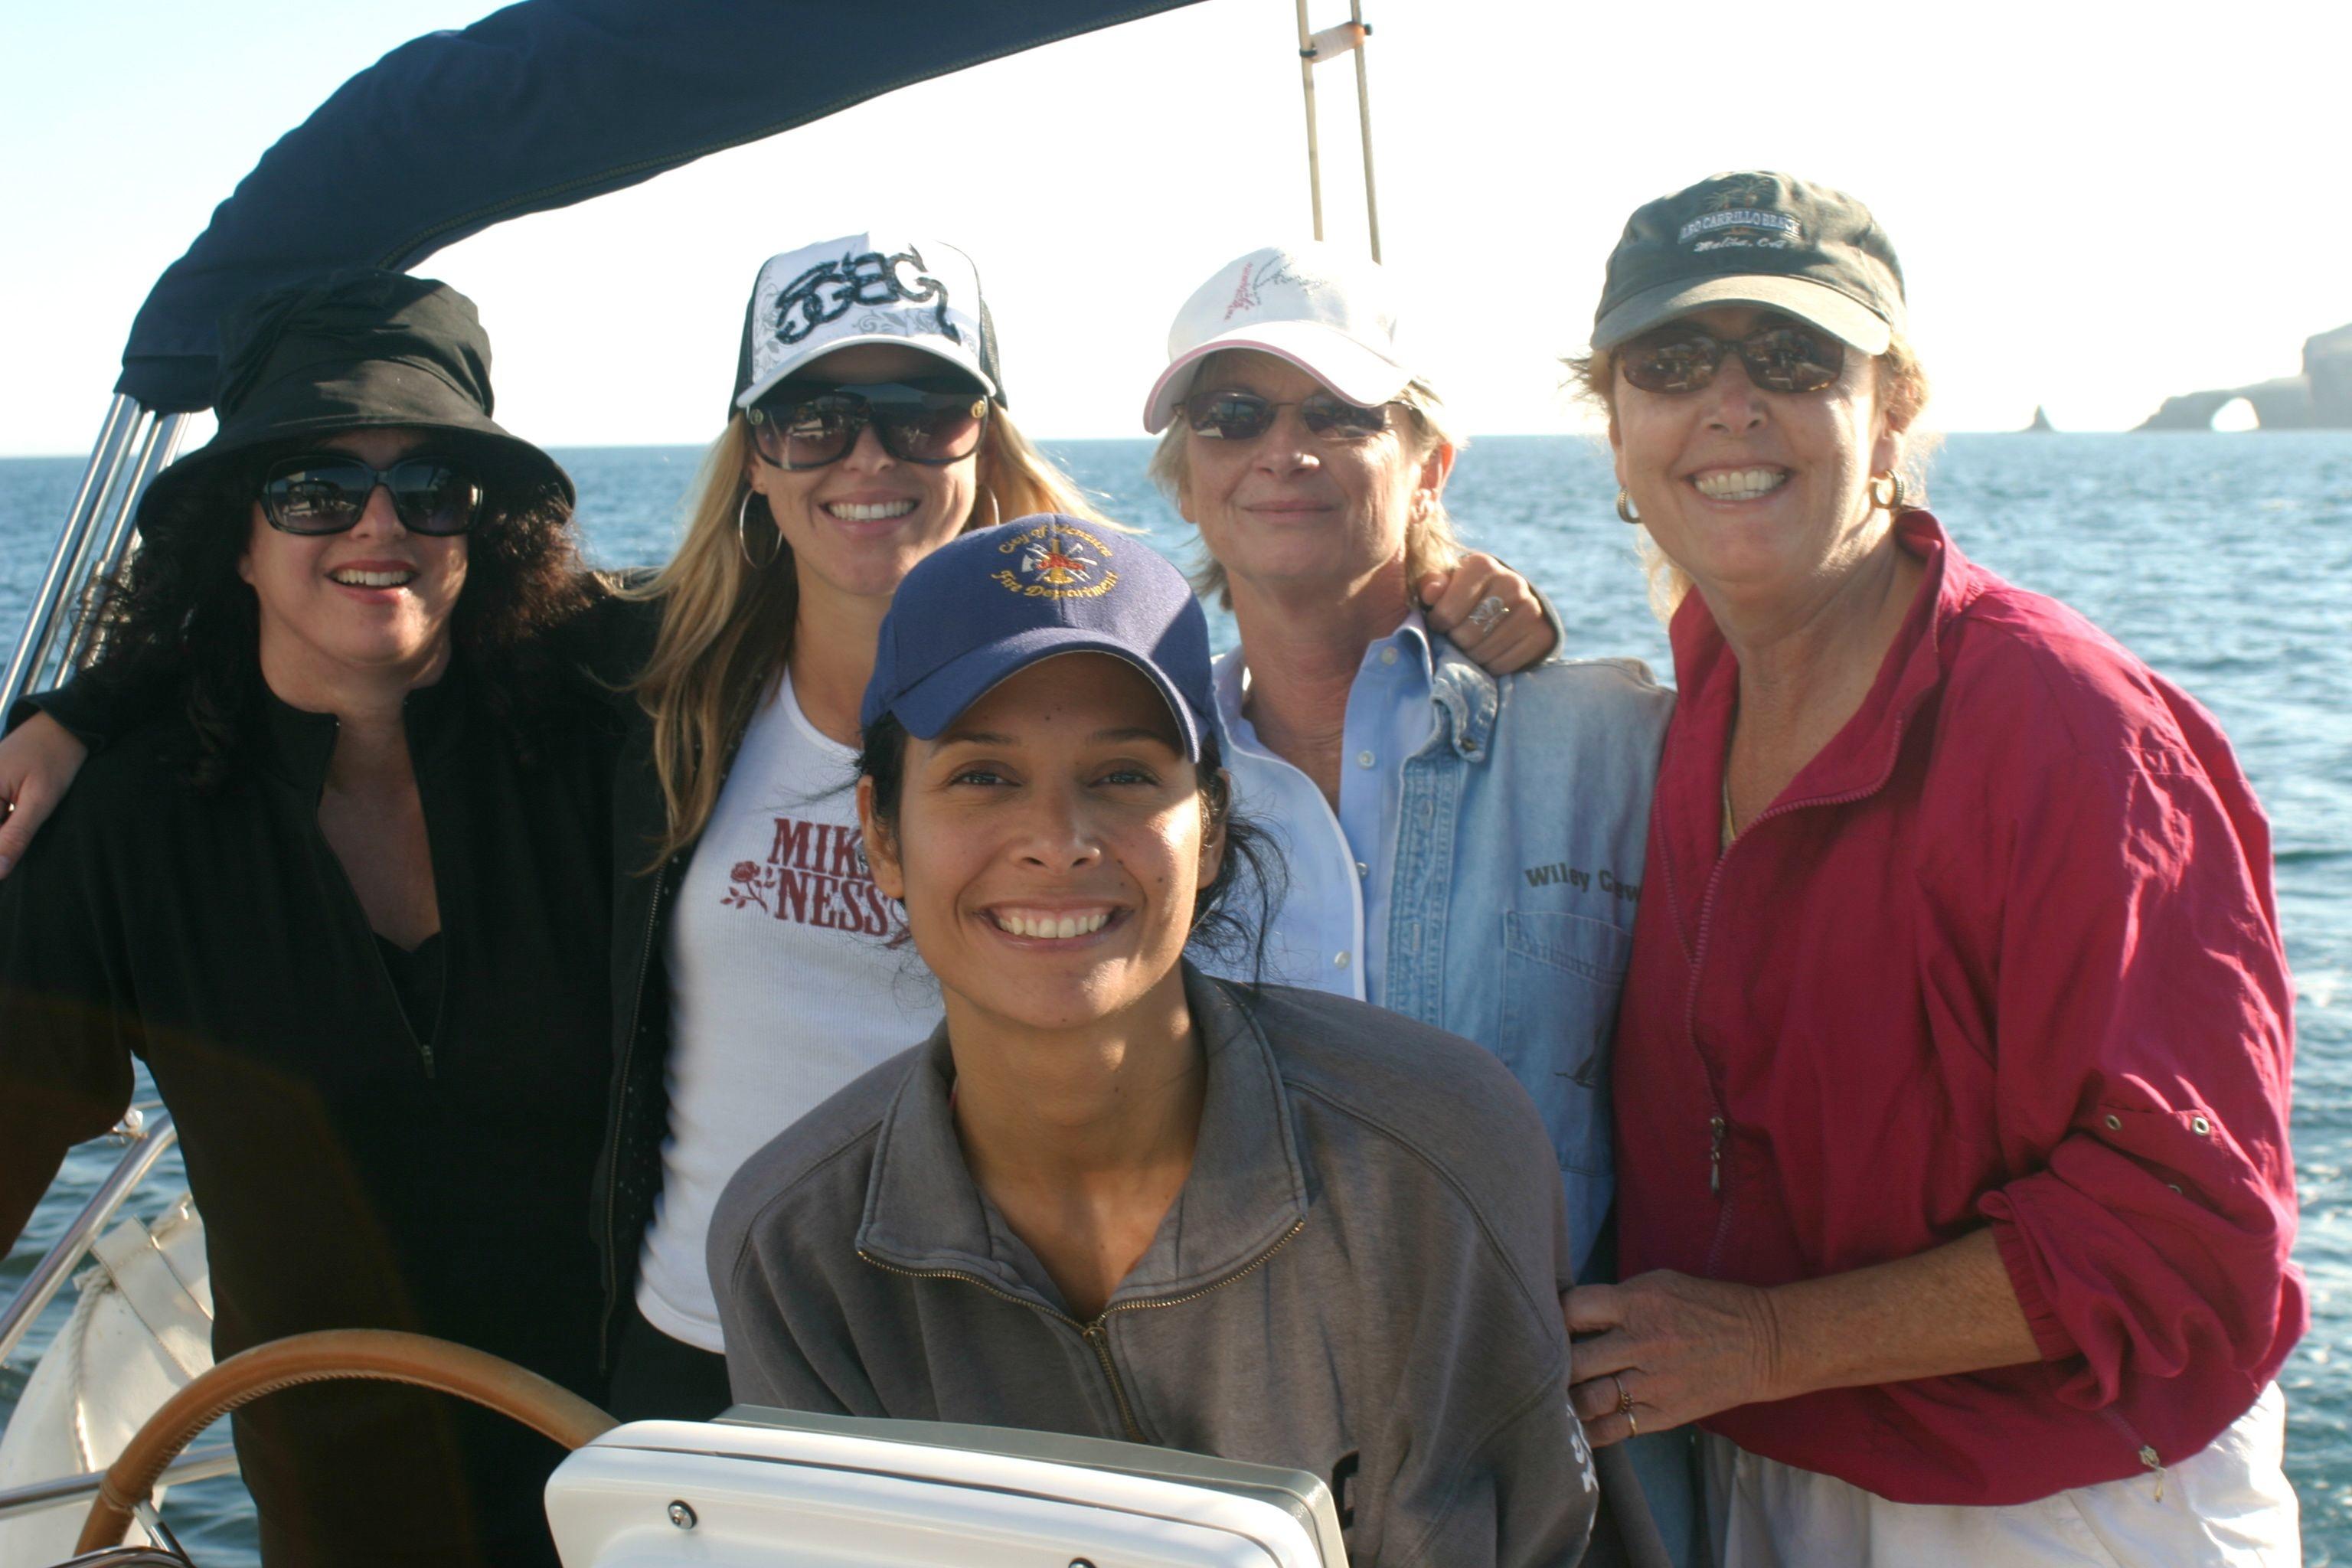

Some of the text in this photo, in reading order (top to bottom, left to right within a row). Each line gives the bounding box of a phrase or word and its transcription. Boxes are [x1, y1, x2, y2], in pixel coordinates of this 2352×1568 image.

[1031, 524, 1048, 539] of
[1023, 569, 1119, 600] Department
[766, 818, 874, 881] MIK
[1524, 862, 1590, 893] Wiley
[773, 867, 888, 937] NESS
